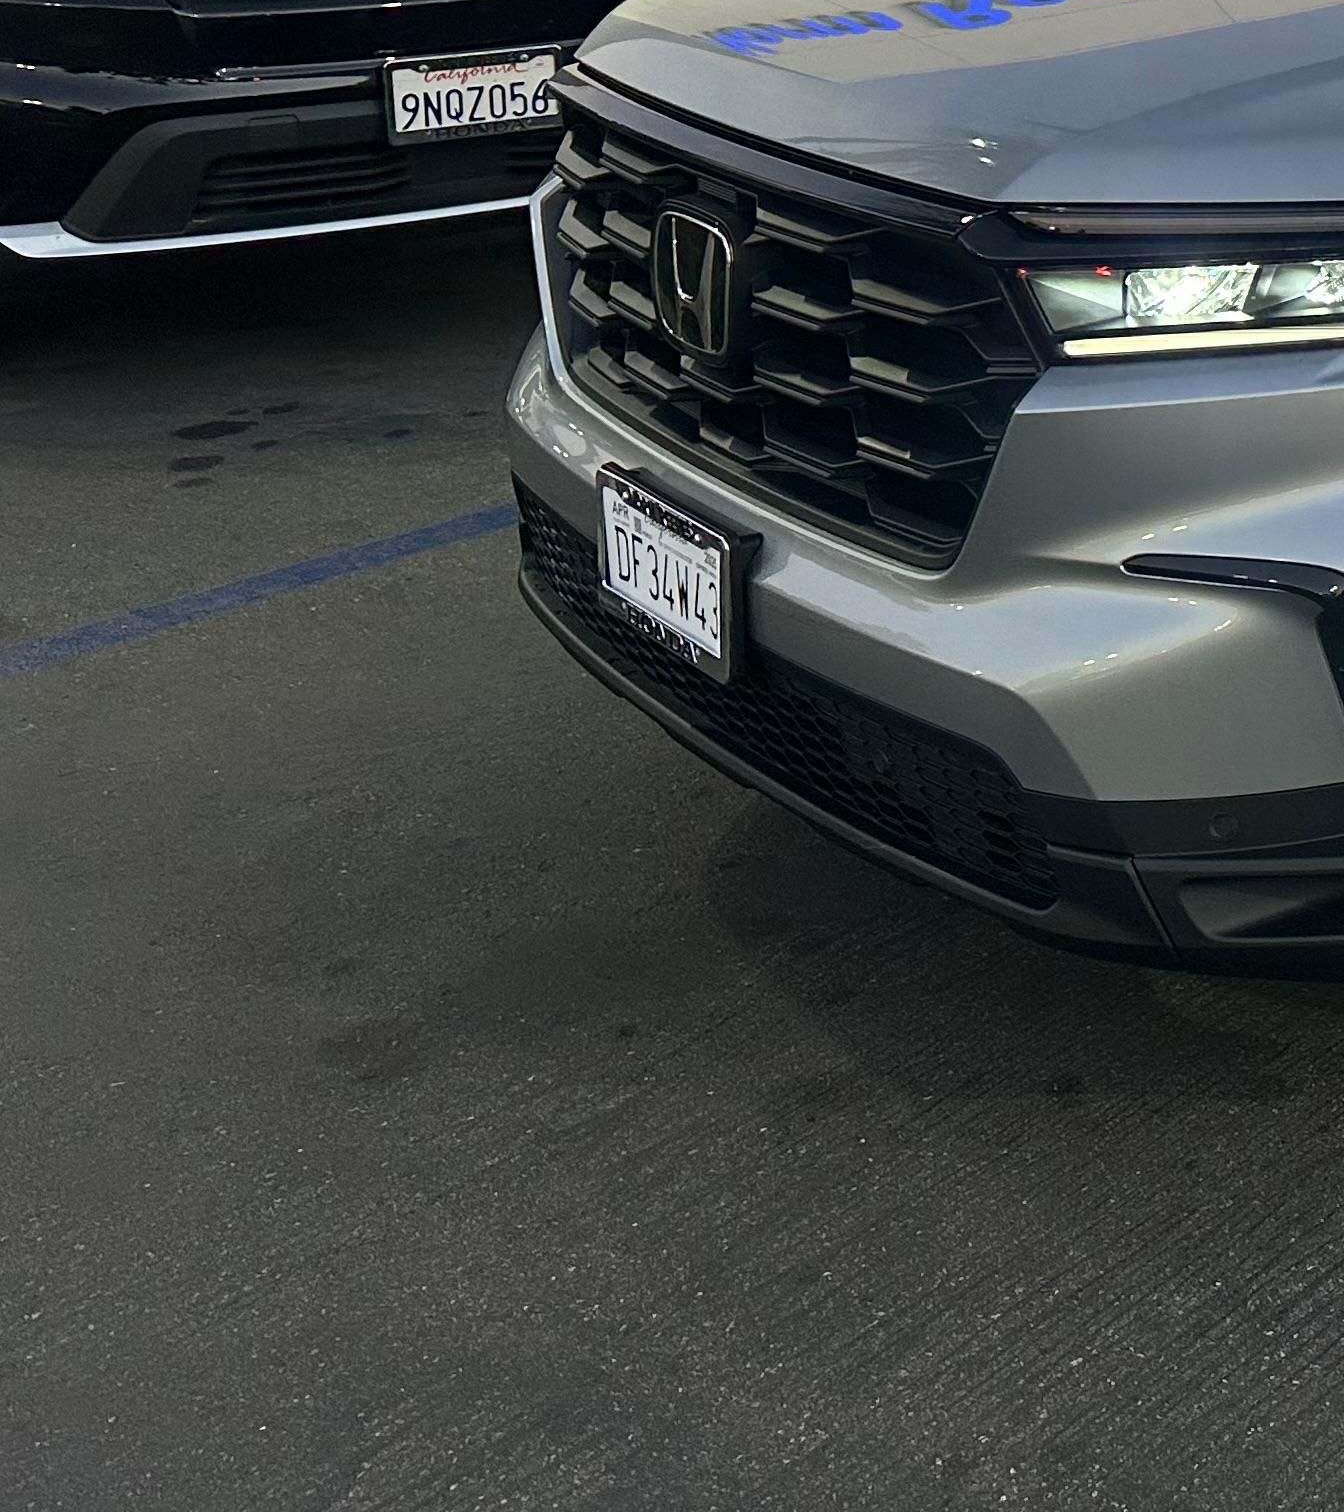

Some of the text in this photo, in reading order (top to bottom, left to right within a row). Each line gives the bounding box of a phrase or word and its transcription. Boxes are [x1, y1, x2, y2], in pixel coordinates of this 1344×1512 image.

[401, 78, 551, 131] 9NQZ056
[433, 119, 530, 139] HONDA
[614, 525, 719, 641] DF34W43
[626, 604, 699, 665] HONDA
